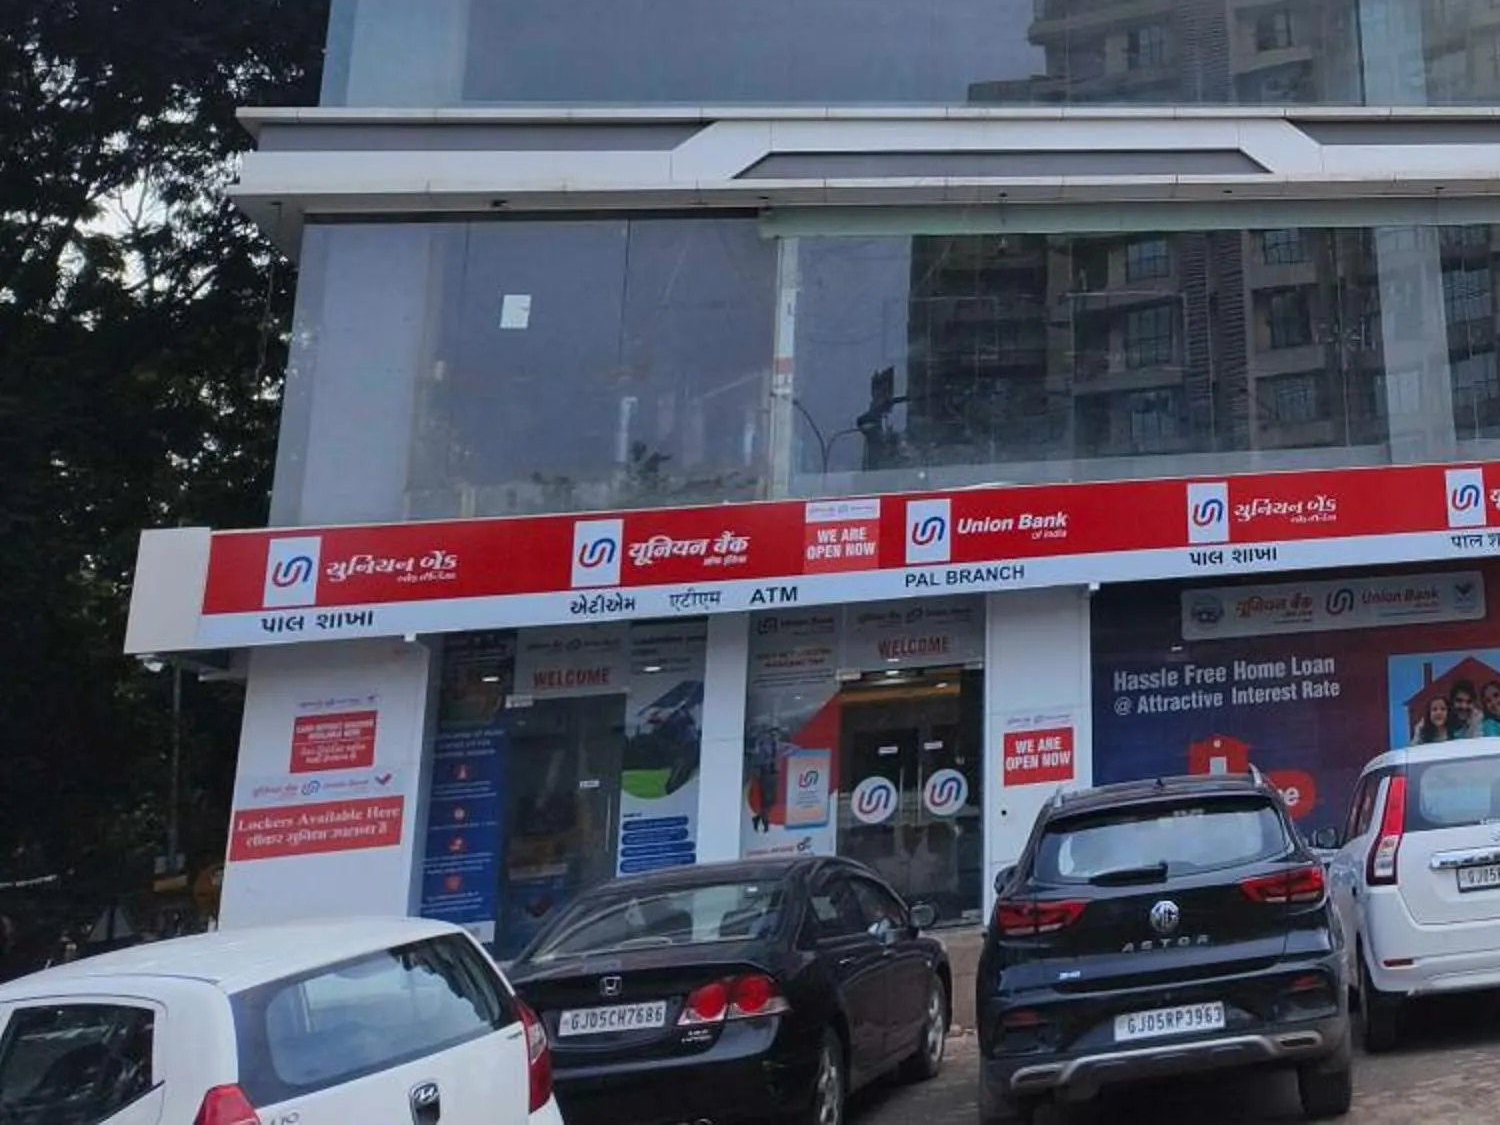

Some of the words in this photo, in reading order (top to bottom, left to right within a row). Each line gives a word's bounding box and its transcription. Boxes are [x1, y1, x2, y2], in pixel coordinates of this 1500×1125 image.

[957, 518, 1013, 535] Union
[1018, 511, 1068, 532] Bank
[817, 529, 837, 543] WE
[841, 526, 867, 541] ARE
[1031, 530, 1042, 540] of
[1451, 534, 1483, 549] पाल
[806, 544, 841, 560] OPEN
[845, 541, 876, 557] NOW
[1189, 550, 1223, 566] પાલ
[1231, 546, 1278, 564] શાખા
[905, 572, 940, 588] PAL
[945, 565, 1025, 586] BRANCH
[570, 591, 636, 615] એટીએમ
[668, 588, 722, 611] एटीएम
[750, 586, 798, 605] ATM
[1362, 589, 1402, 606] Union
[1404, 587, 1440, 604] Bank
[260, 615, 304, 633] પાલ
[315, 609, 374, 630] શાખા
[877, 636, 950, 658] WELCOME
[533, 667, 610, 689] WELCOME
[1114, 668, 1179, 692] Hassle
[1184, 664, 1227, 686] Free
[1233, 660, 1286, 681] Home
[1291, 656, 1335, 676] Loan
[1114, 696, 1133, 716] @
[1137, 689, 1223, 715] Attractive
[1231, 682, 1298, 706] Interest
[1302, 680, 1341, 700] Rate
[1015, 739, 1035, 754] WE
[1037, 736, 1062, 752] ARE
[1005, 755, 1039, 772] OPEN
[1041, 750, 1071, 768] NOW
[237, 814, 294, 832] Lockers
[296, 809, 363, 826] Available
[366, 806, 401, 821] Here
[1121, 934, 1209, 954] ASTOR
[1126, 1006, 1222, 1035] GJ05RP3963
